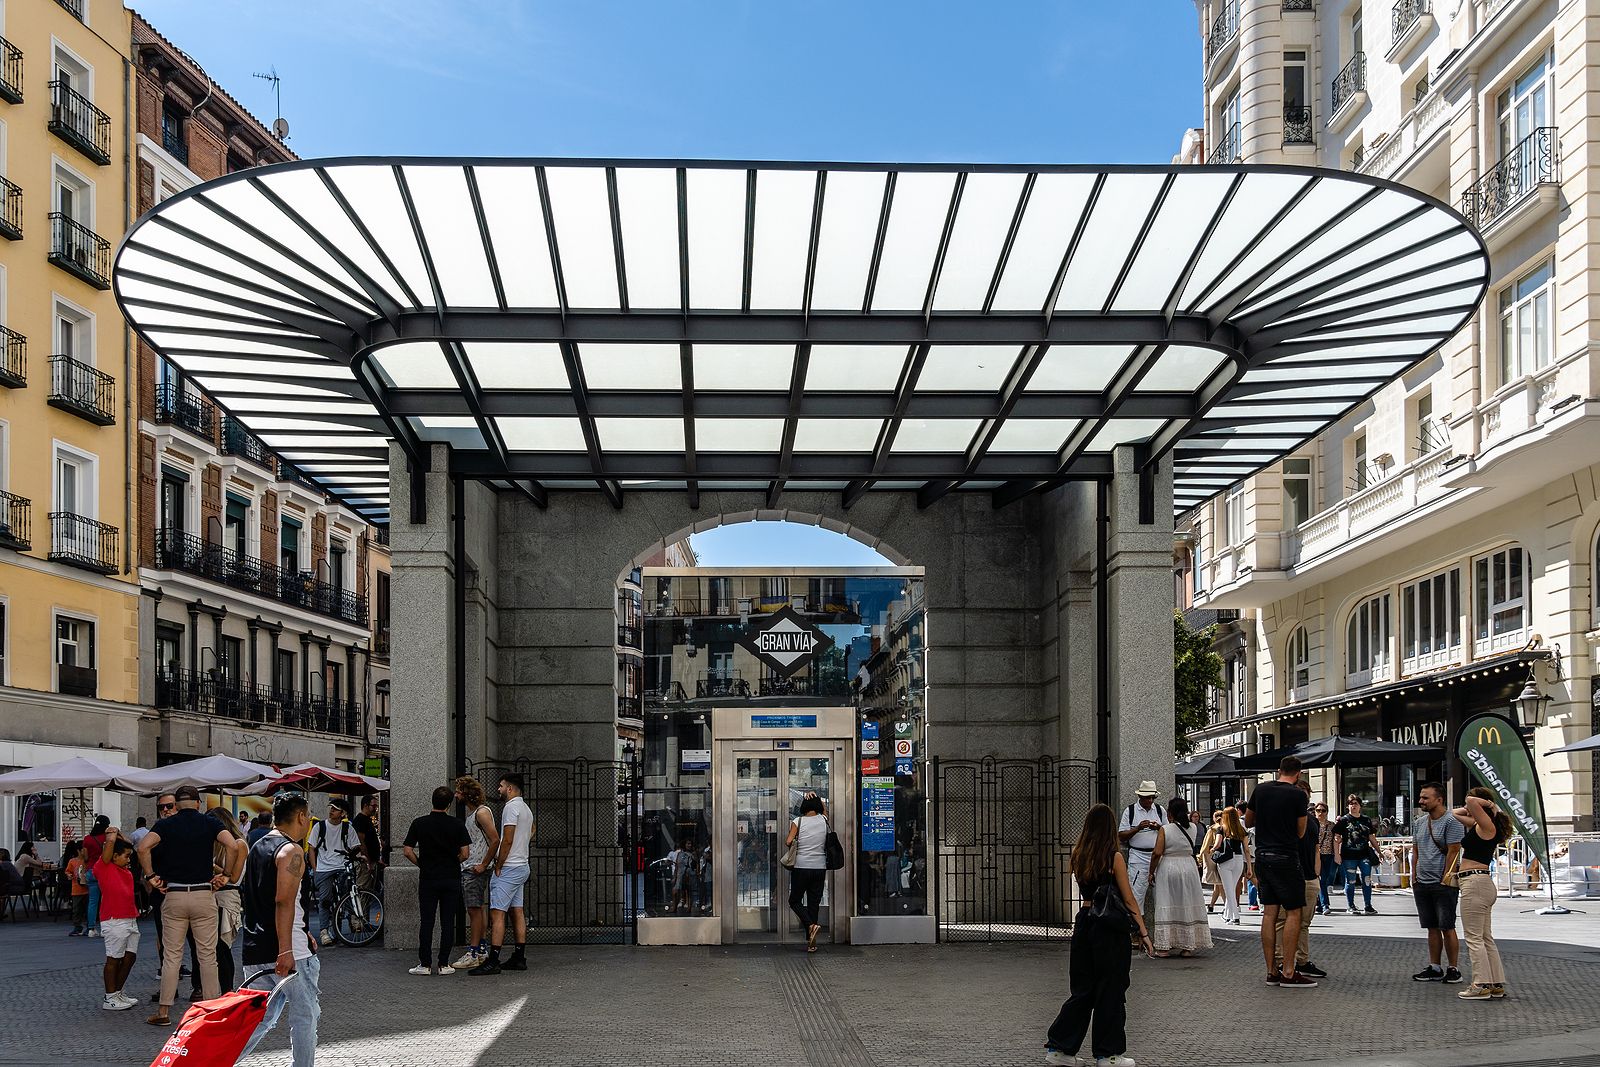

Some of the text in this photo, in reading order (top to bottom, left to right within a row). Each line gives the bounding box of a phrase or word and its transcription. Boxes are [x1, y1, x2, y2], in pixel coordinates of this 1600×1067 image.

[761, 631, 810, 651] GRAN VÍA
[1391, 719, 1448, 745] TAPA TAPA
